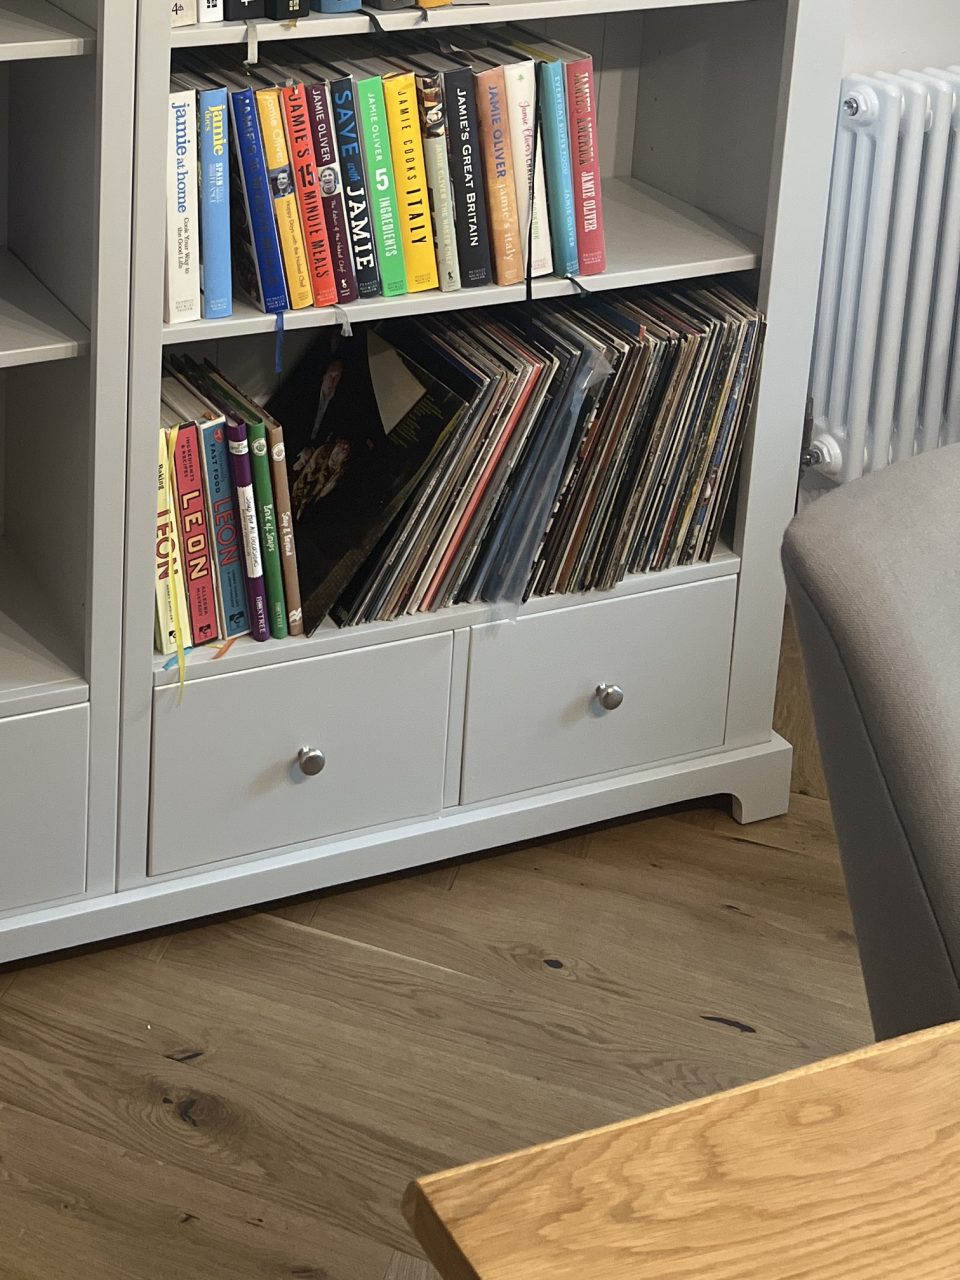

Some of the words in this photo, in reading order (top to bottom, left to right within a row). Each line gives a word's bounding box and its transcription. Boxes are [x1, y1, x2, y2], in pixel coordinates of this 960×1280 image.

[288, 92, 310, 160] JAMIE'S
[312, 89, 325, 122] JAMIE
[334, 90, 359, 158] SAVE
[456, 88, 470, 141] JAMIE'S
[172, 103, 191, 156] jamie
[317, 124, 331, 162] OLIVER
[177, 158, 187, 170] at
[298, 164, 316, 188] 15
[376, 168, 389, 191] 5
[461, 144, 475, 188] GREAT
[176, 172, 189, 213] home
[303, 191, 321, 236] MINUTE
[346, 186, 374, 270] JAMIE
[379, 196, 398, 257] INGREDIENTS
[406, 188, 427, 245] ITALY
[466, 193, 479, 247] BRITAIN
[311, 239, 330, 278] MEALS
[210, 443, 218, 464] FAST
[213, 469, 221, 493] FOOD
[180, 489, 209, 581] LEON
[213, 497, 241, 567] LEON
